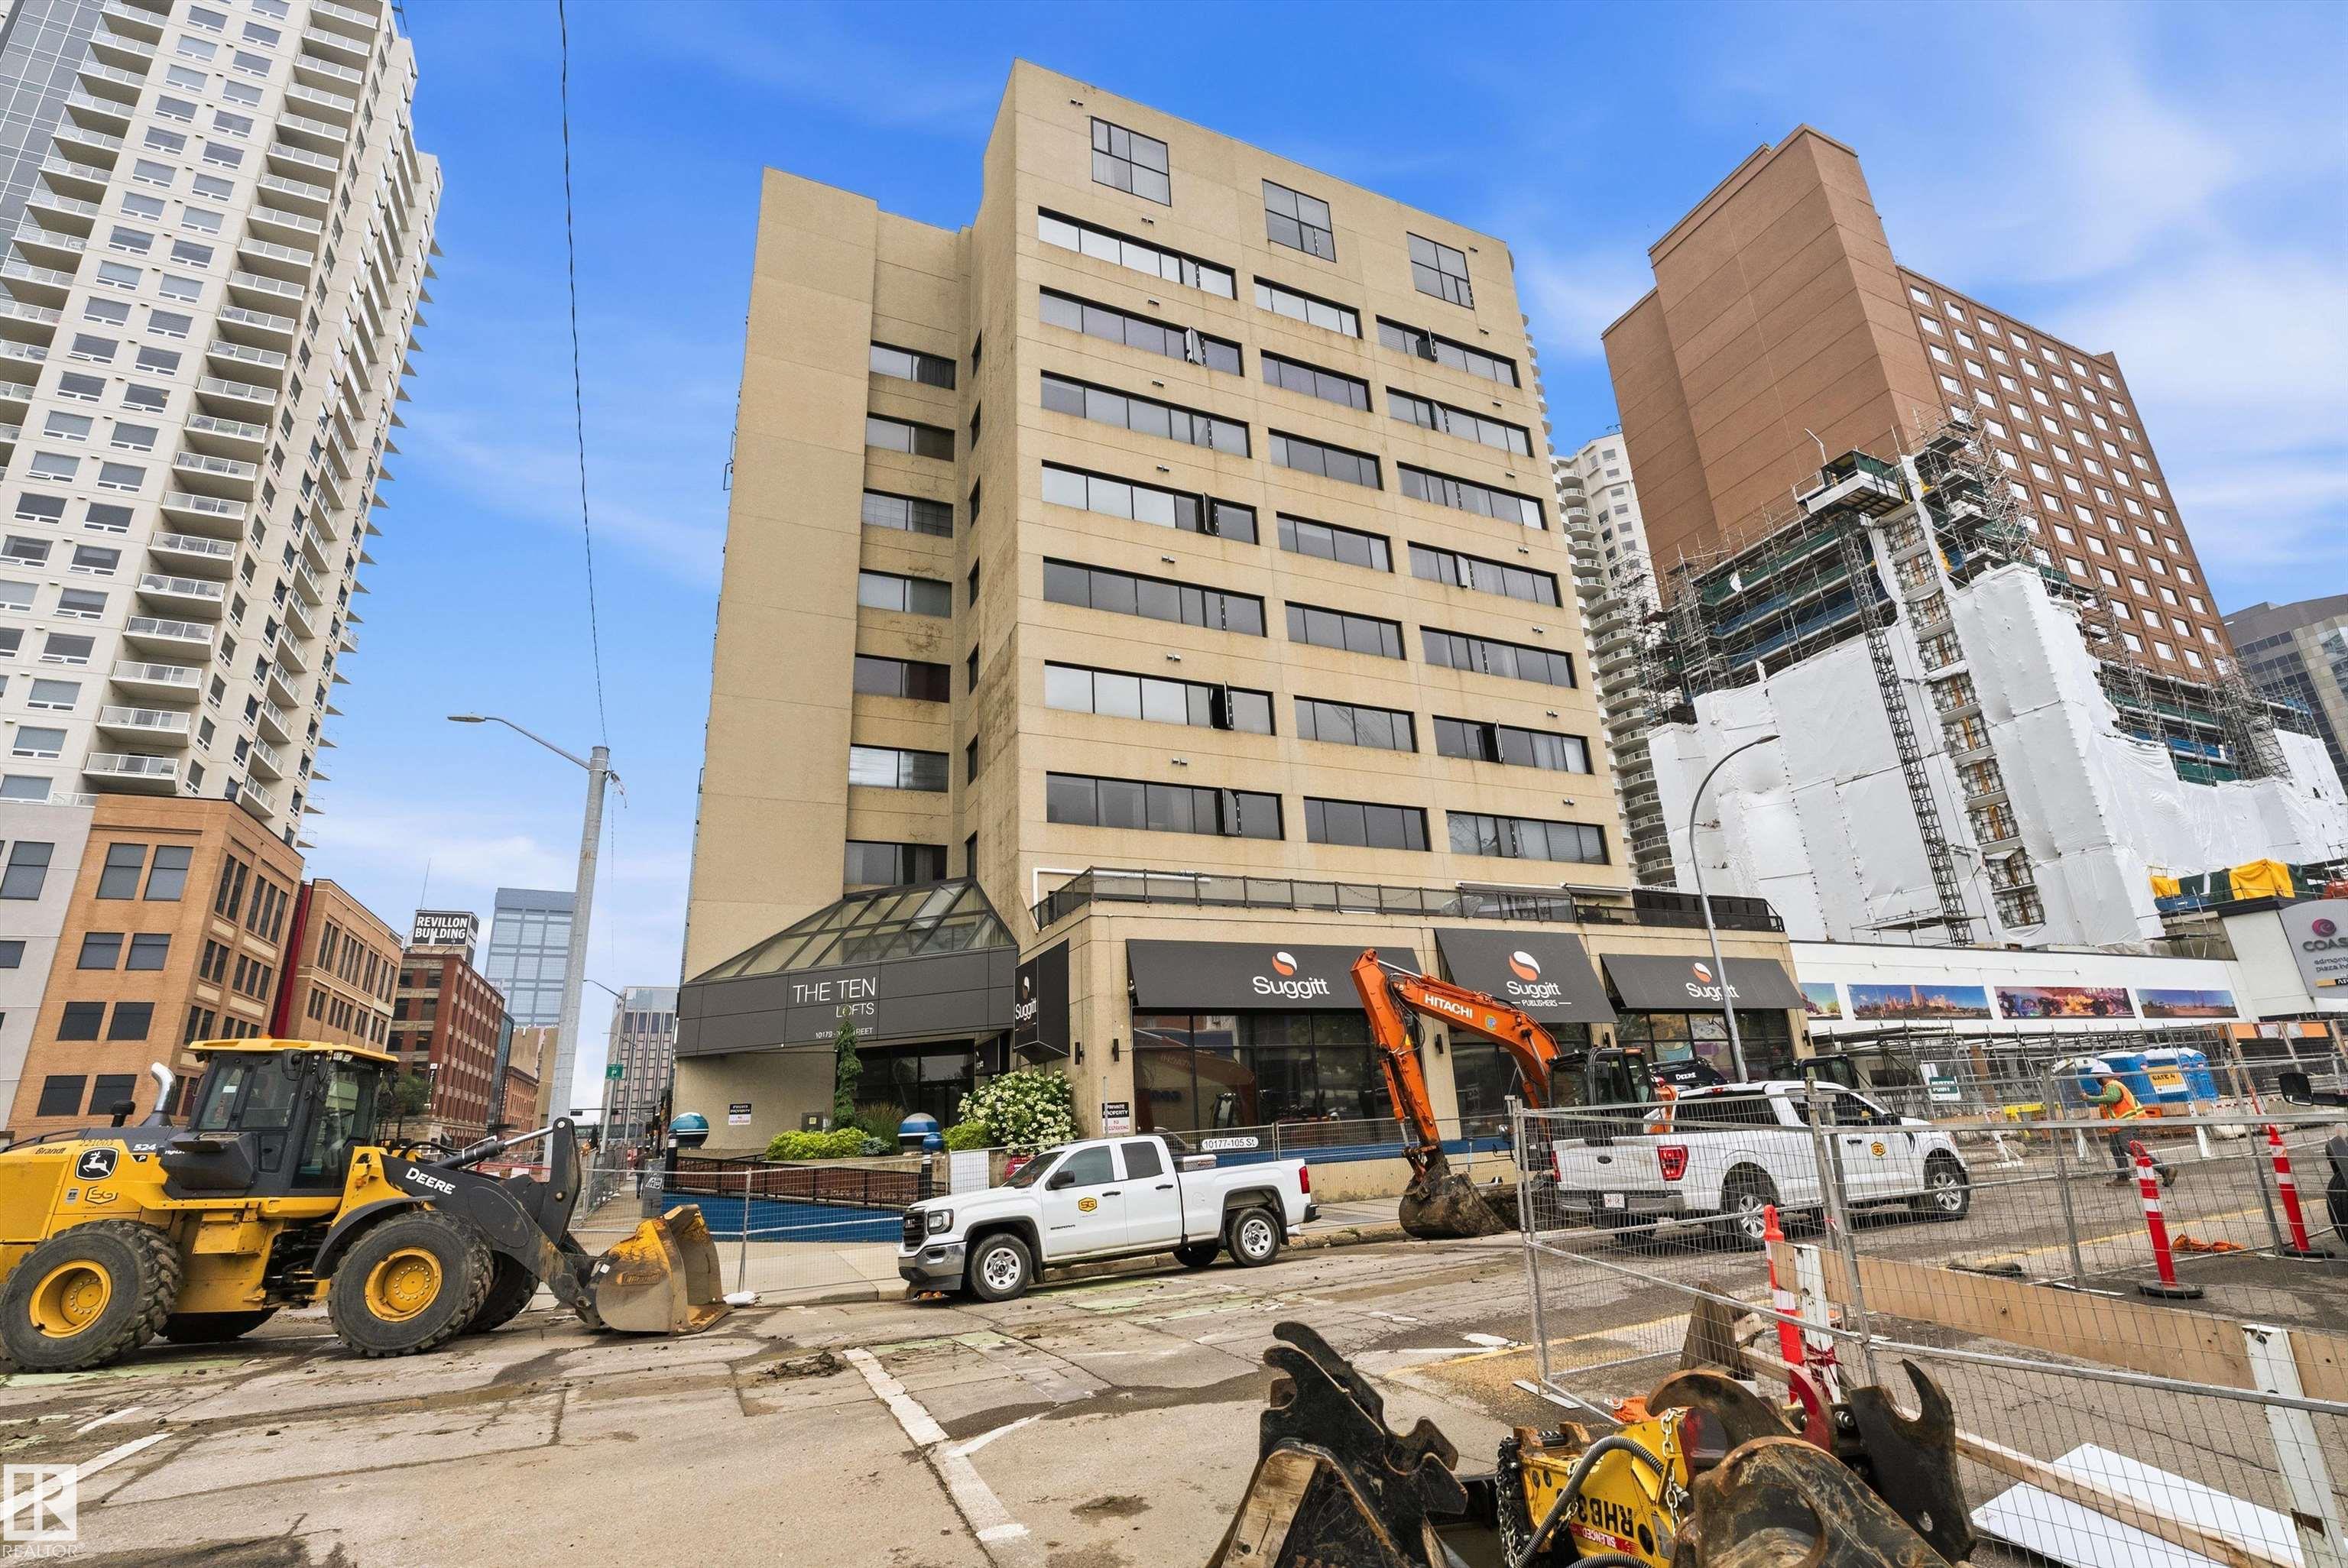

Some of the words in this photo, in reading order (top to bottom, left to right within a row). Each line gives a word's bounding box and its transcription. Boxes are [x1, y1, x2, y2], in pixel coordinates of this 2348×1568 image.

[417, 916, 468, 928] REVILLON
[2302, 937, 2348, 952] COAS
[793, 982, 832, 1003] THE
[837, 977, 876, 999] TEN
[1252, 976, 1331, 999] Suggitt
[1506, 981, 1562, 999] Suggitt
[1685, 983, 1740, 1002] Suggtt
[835, 1002, 874, 1018] LOFTS
[1015, 997, 1037, 1021] Suggitt
[1425, 994, 1474, 1019] HITACHI
[851, 1027, 874, 1036] REET
[1205, 1138, 1245, 1149] 10177-105
[405, 1167, 456, 1195] DEERE
[1582, 1528, 1617, 1550] SILENCED
